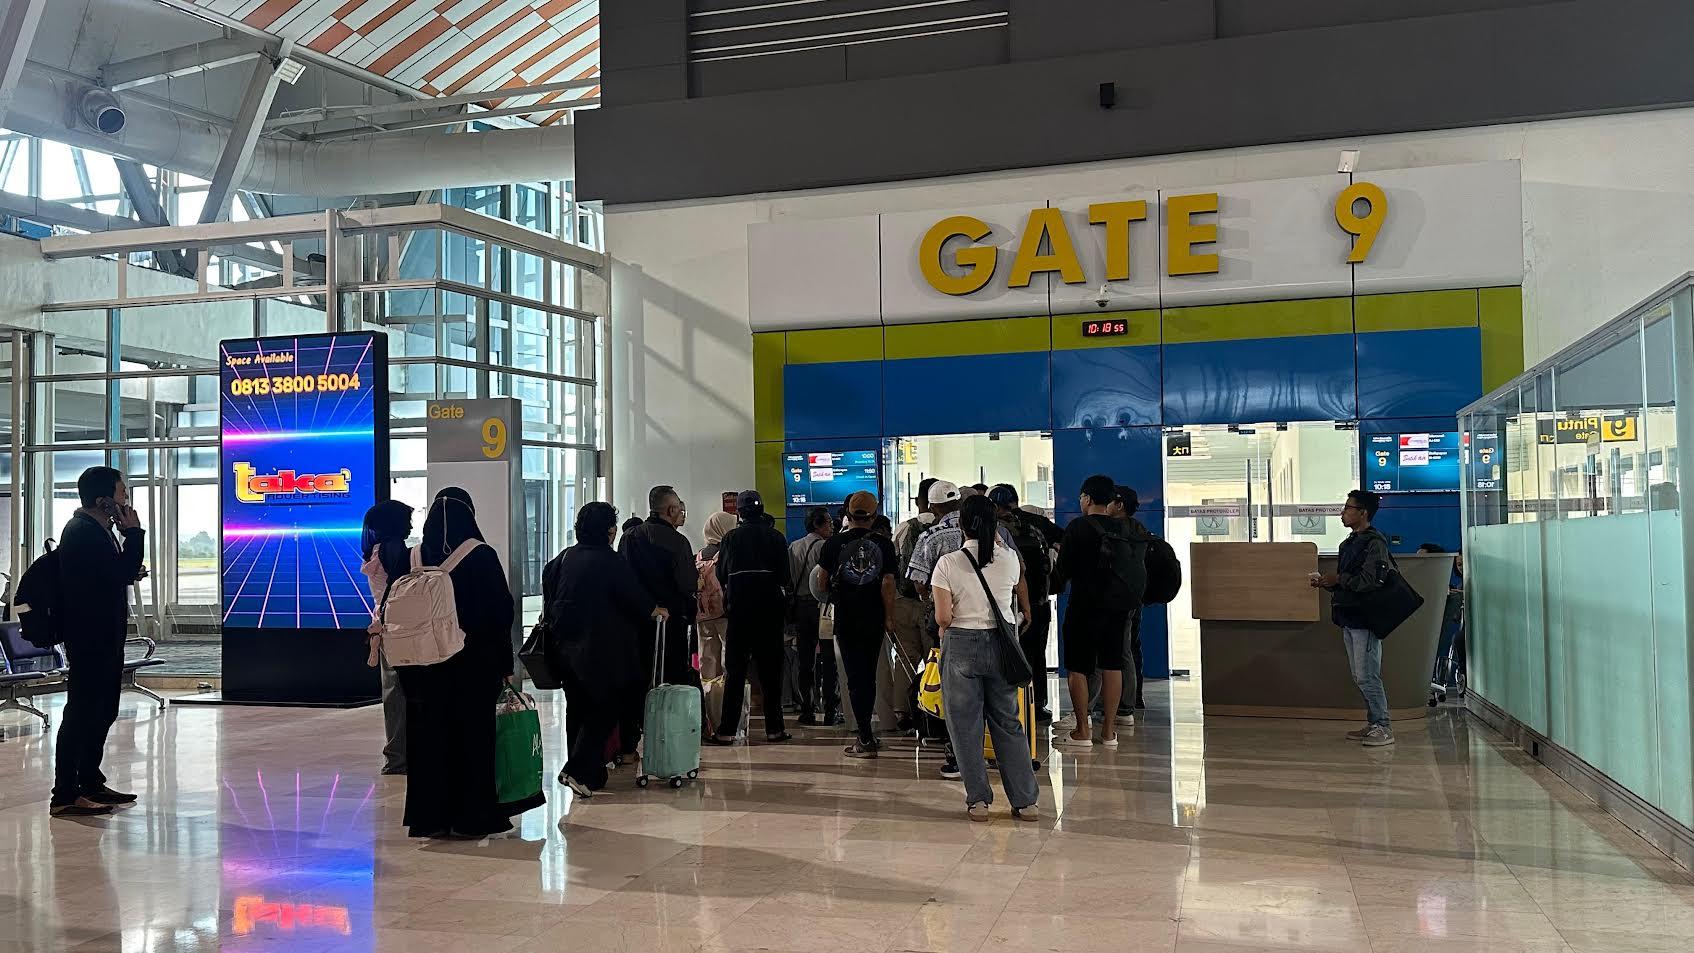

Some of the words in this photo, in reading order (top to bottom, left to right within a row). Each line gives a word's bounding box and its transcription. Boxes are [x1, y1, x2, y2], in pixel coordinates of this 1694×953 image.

[920, 192, 1219, 295] GATE
[1335, 182, 1388, 264] 9
[225, 355, 252, 369] Space
[254, 352, 294, 365] Available
[231, 377, 270, 396] 0813
[272, 374, 315, 395] 3800
[317, 372, 360, 393] 5004
[429, 404, 465, 419] Gate
[481, 417, 507, 459] 9
[1378, 456, 1387, 467] 9
[793, 474, 801, 482] 9
